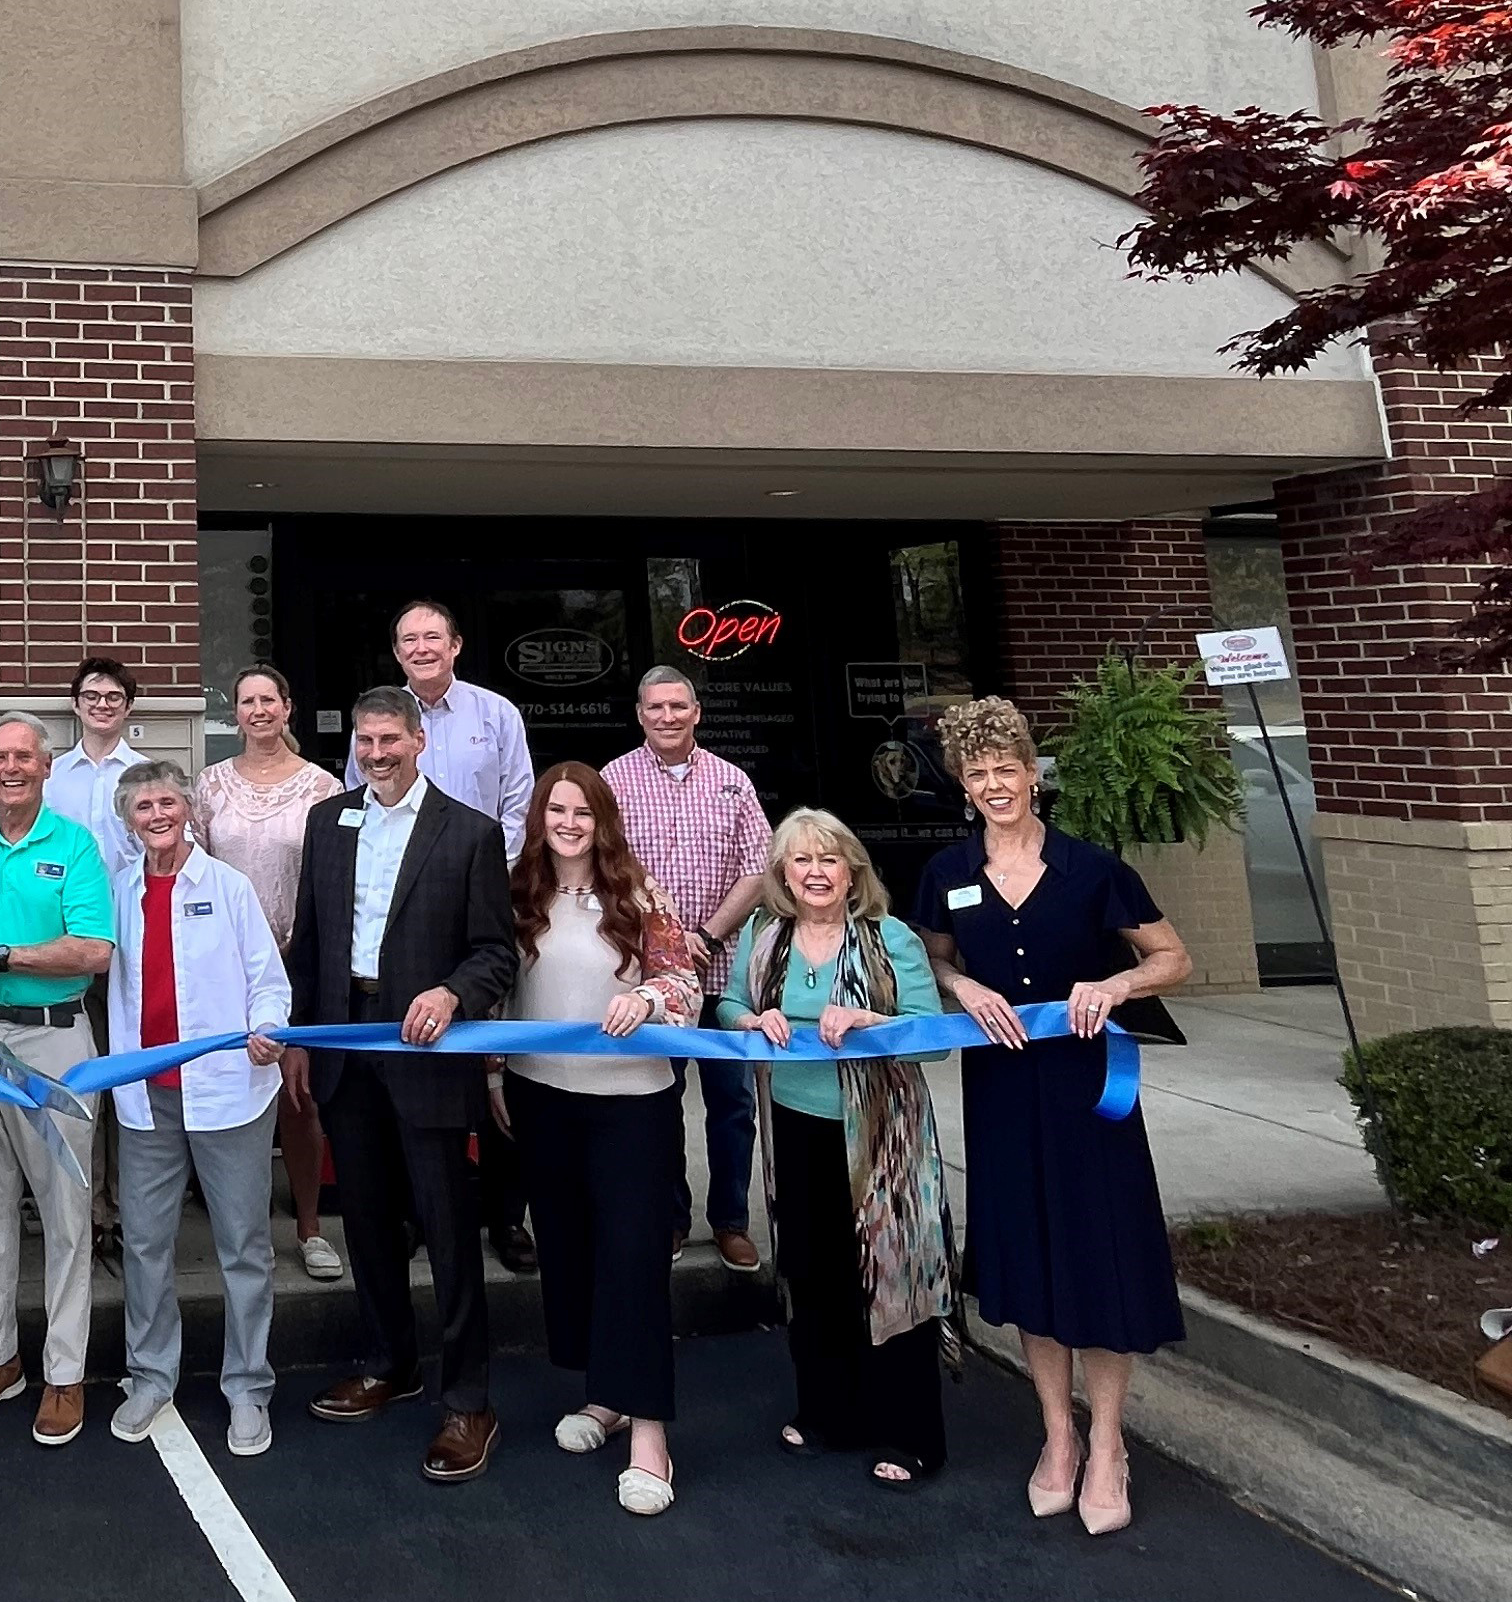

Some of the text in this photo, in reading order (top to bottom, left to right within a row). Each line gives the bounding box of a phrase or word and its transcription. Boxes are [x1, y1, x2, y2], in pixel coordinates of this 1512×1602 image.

[677, 607, 783, 656] Open
[707, 682, 742, 692] CORE
[743, 682, 793, 692] VALUES
[133, 727, 141, 737] 5
